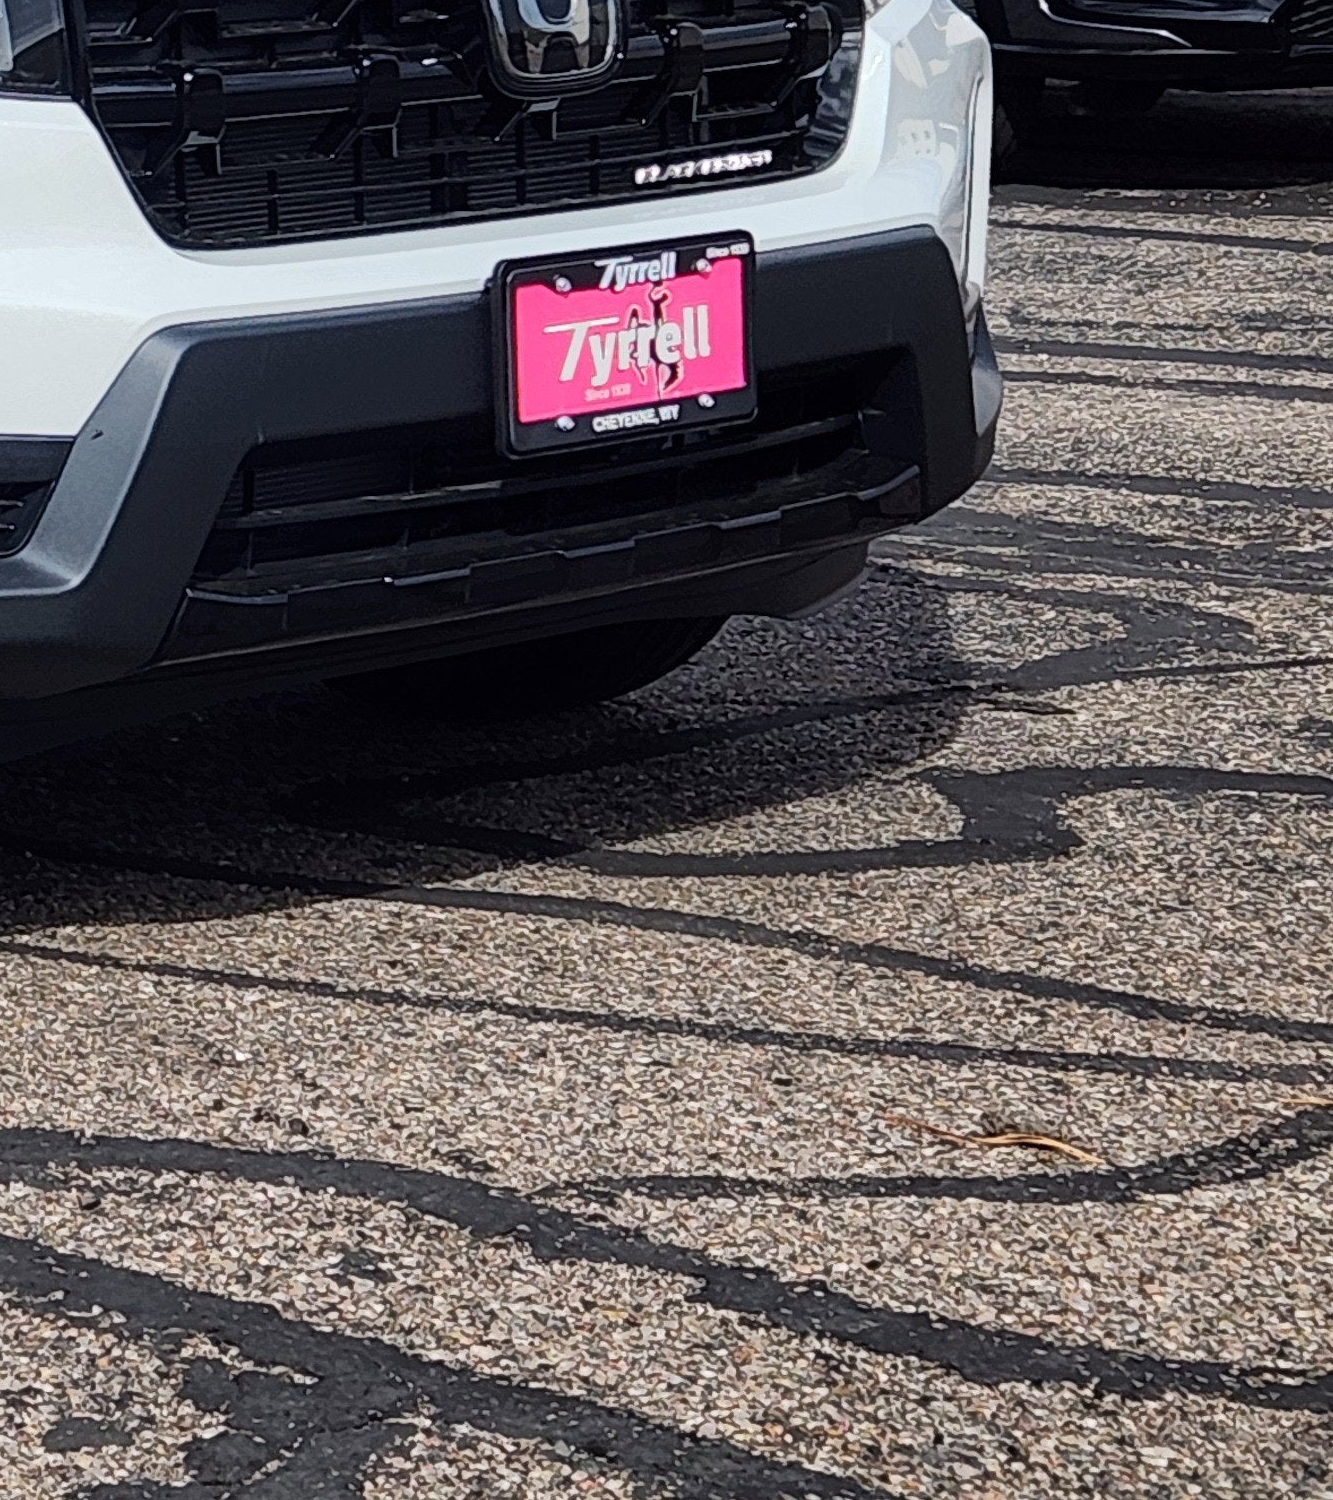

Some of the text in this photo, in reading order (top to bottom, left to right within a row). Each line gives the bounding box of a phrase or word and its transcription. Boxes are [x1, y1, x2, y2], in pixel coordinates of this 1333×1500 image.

[594, 251, 677, 291] Tyrrell
[543, 304, 711, 387] Tyrrell
[592, 404, 680, 433] CHEYENNE, WY
